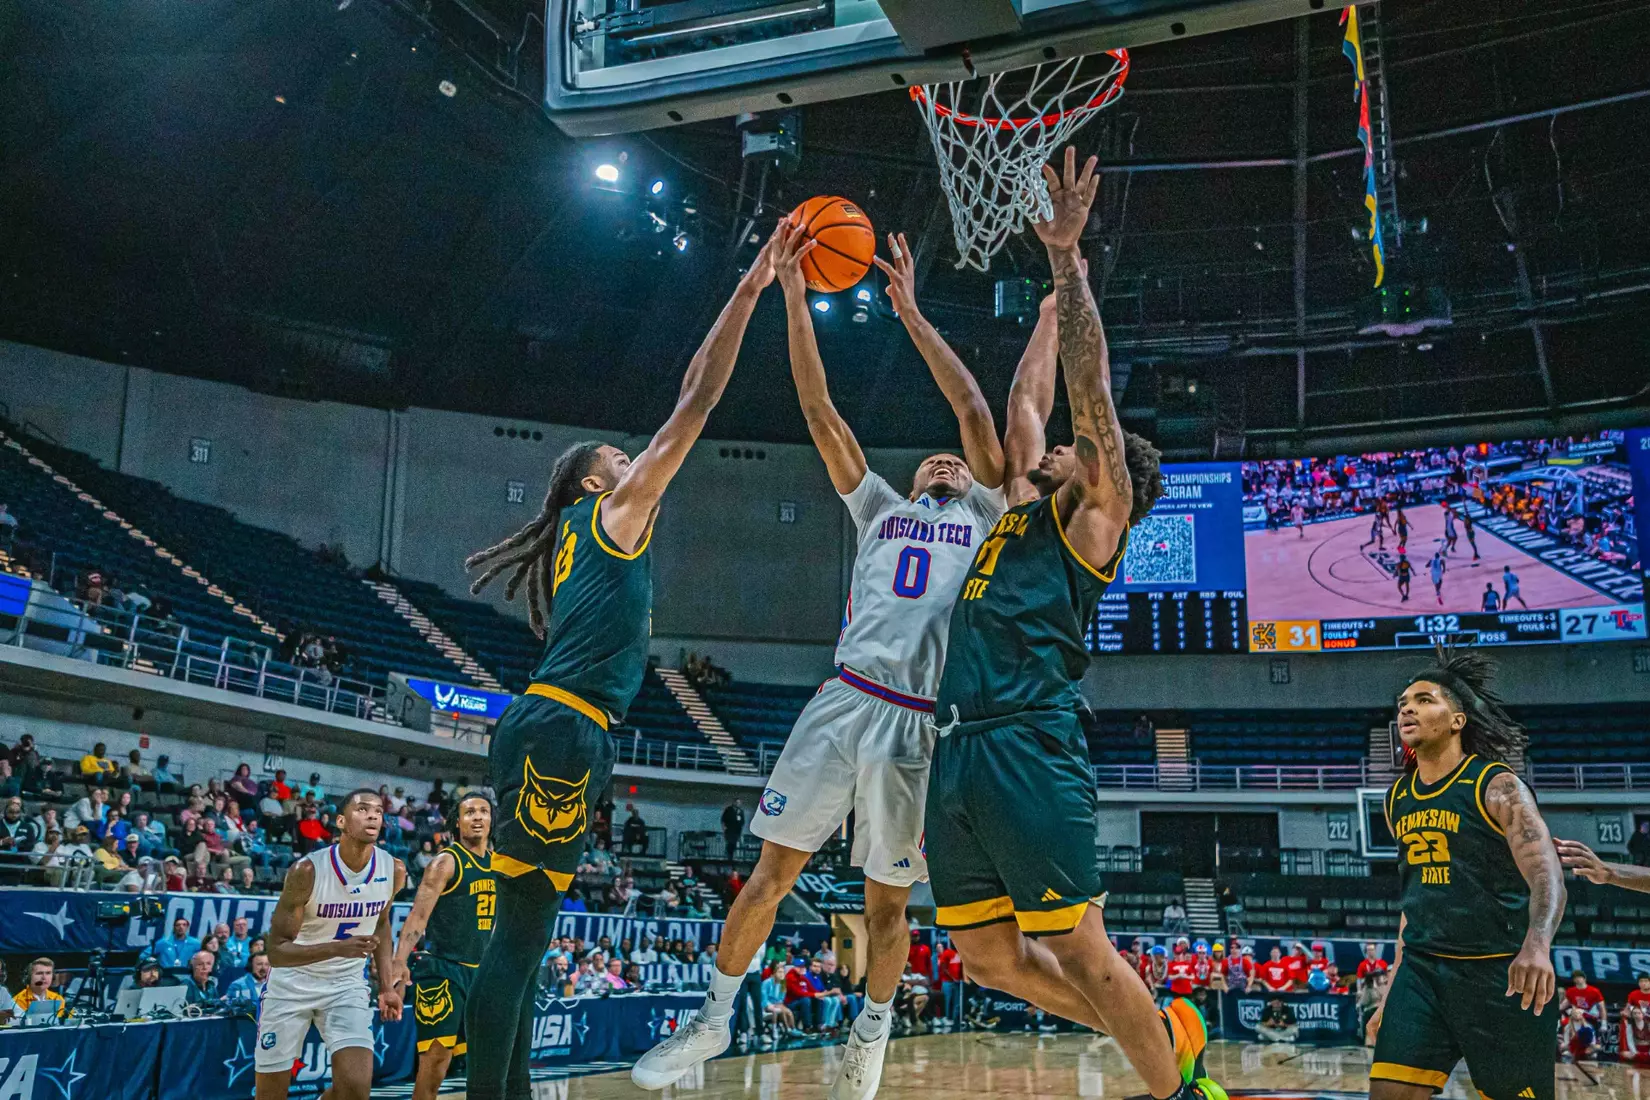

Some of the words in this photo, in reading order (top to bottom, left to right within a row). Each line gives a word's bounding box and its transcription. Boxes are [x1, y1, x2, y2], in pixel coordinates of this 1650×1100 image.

[1170, 472, 1232, 485] CHAMPIONSHIPS
[937, 523, 972, 548] TECH
[892, 545, 932, 599] 0
[1223, 591, 1244, 599] FOUL
[1323, 621, 1363, 631] TIMEOUTS
[1414, 615, 1459, 633] 1:32
[1499, 612, 1543, 624] TIMEOUTS
[1565, 614, 1599, 636] 27
[1289, 625, 1317, 647] 31
[1323, 631, 1348, 640] FOULS
[1517, 623, 1545, 633] FOULS
[1323, 639, 1357, 649] BONUS
[1480, 632, 1507, 643] POSS
[1329, 821, 1349, 839] 212
[1396, 808, 1460, 840] KENNESAW
[1599, 823, 1622, 842] 213
[1402, 831, 1450, 865] 23
[1421, 866, 1451, 884] STATE
[316, 903, 364, 918] LOUISIANA
[476, 894, 496, 917] 21
[993, 1001, 1027, 1012] SPORT
[1241, 1006, 1262, 1020] HSC
[1285, 1002, 1340, 1020] TSVILLE
